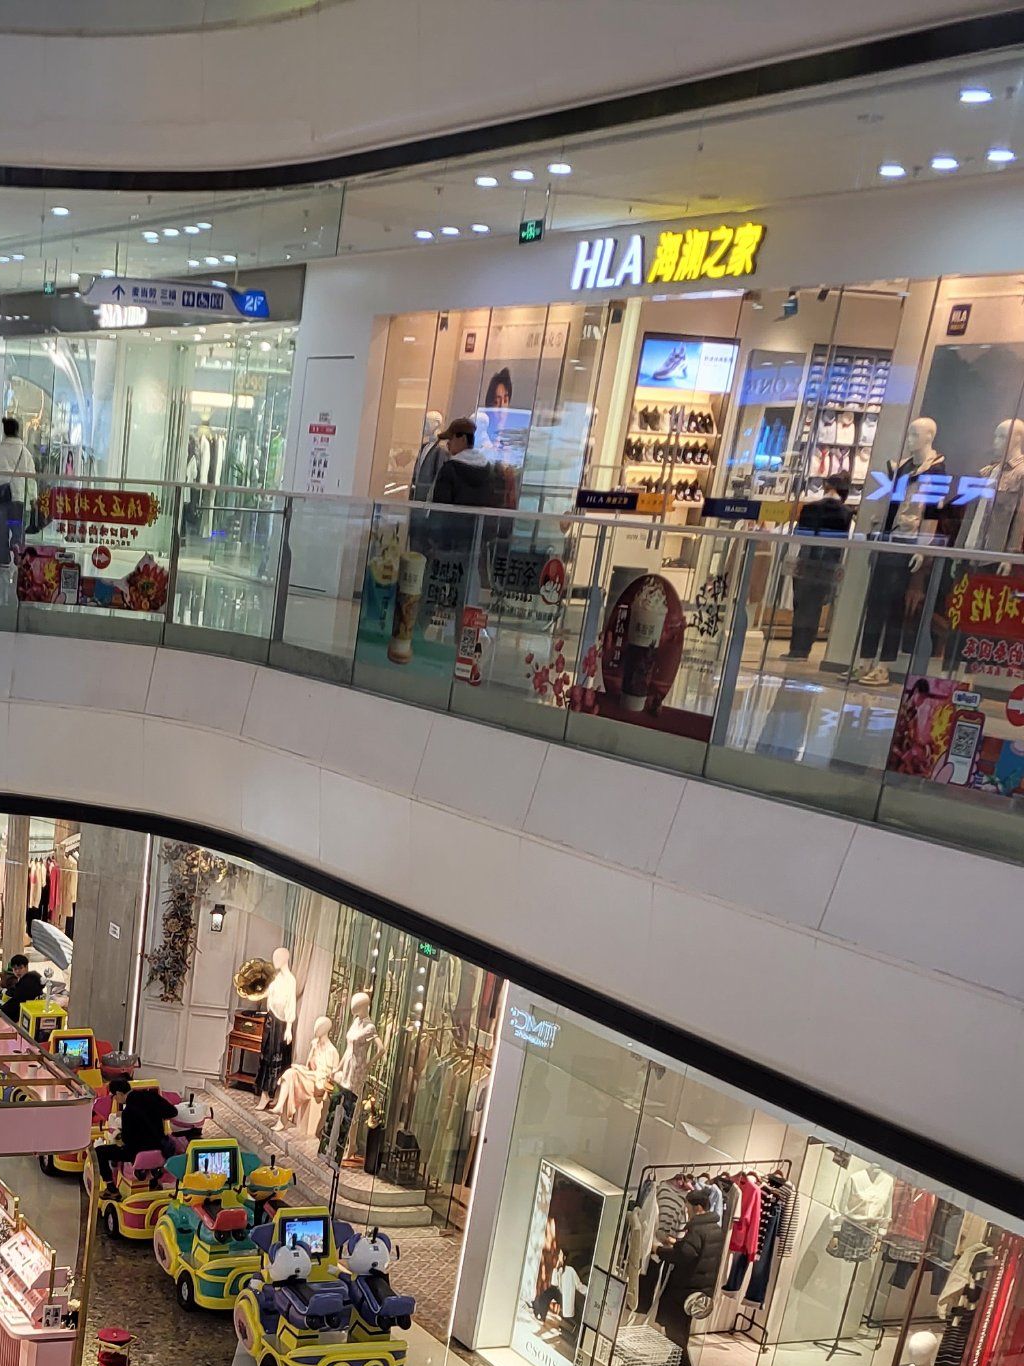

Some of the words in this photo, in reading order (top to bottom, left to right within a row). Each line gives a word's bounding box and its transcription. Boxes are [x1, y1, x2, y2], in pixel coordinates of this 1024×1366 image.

[571, 234, 643, 290] HLA
[647, 222, 765, 283] 海澜之家
[244, 295, 264, 312] 2F
